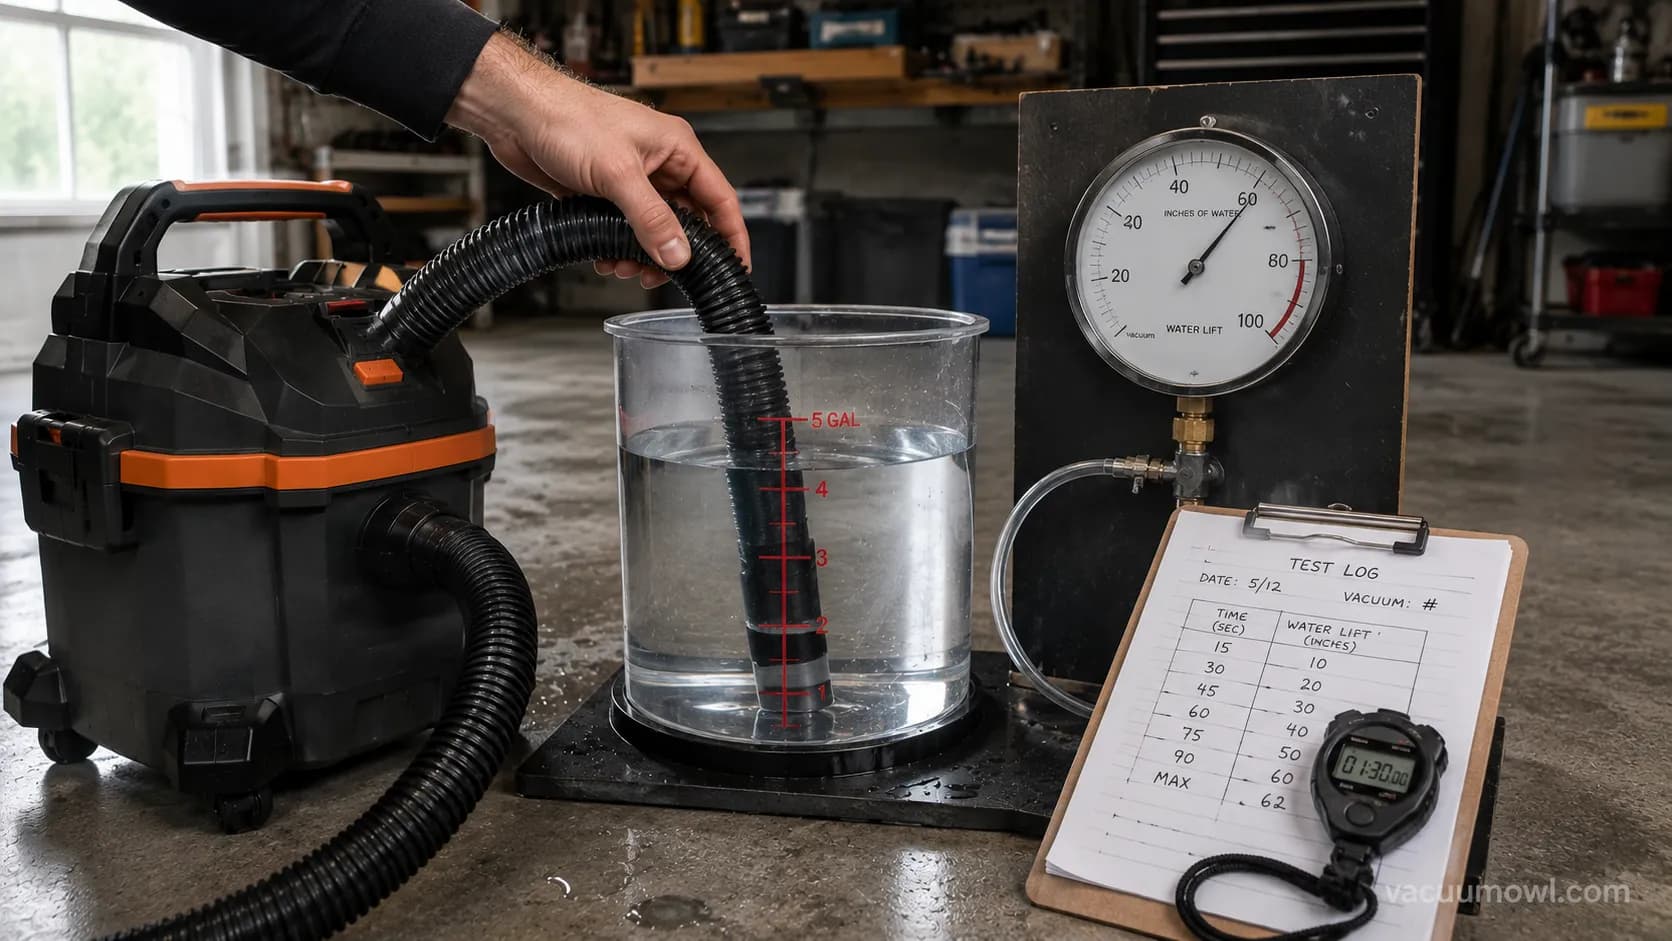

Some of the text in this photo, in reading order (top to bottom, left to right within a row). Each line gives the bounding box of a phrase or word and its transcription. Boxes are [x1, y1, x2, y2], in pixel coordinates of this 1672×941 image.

[1169, 179, 1189, 194] 40
[1237, 191, 1258, 206] 60
[1163, 209, 1195, 217] INCHES
[1197, 209, 1209, 217] OF
[1111, 269, 1130, 283] 20
[1237, 313, 1264, 329] 100
[1166, 324, 1223, 335] WATER LIFT
[812, 412, 861, 428] 5 GAL
[815, 481, 829, 498] 4
[816, 550, 828, 568] 3
[1289, 557, 1379, 580] TEST LOG
[1199, 572, 1282, 594] DATE: 5/12
[1343, 591, 1439, 611] VACUUM: #
[1216, 608, 1249, 622] TIME
[816, 616, 829, 634] 2
[1211, 621, 1246, 636] (SEC)
[1287, 620, 1373, 640] WATER LIFT
[1213, 641, 1233, 654] 15
[1204, 660, 1226, 676] 30
[1309, 656, 1328, 670] 10
[817, 686, 827, 700] 1
[1196, 683, 1220, 698] 45
[1299, 678, 1323, 693] 20
[1188, 704, 1211, 720] 60
[1293, 699, 1316, 716] 30
[1182, 726, 1205, 742] 75
[1286, 722, 1309, 738] 40
[1173, 748, 1195, 764] 90
[1278, 745, 1302, 761] 50
[1153, 770, 1192, 790] MAX
[1271, 768, 1295, 786] 60
[1260, 795, 1287, 811] 62
